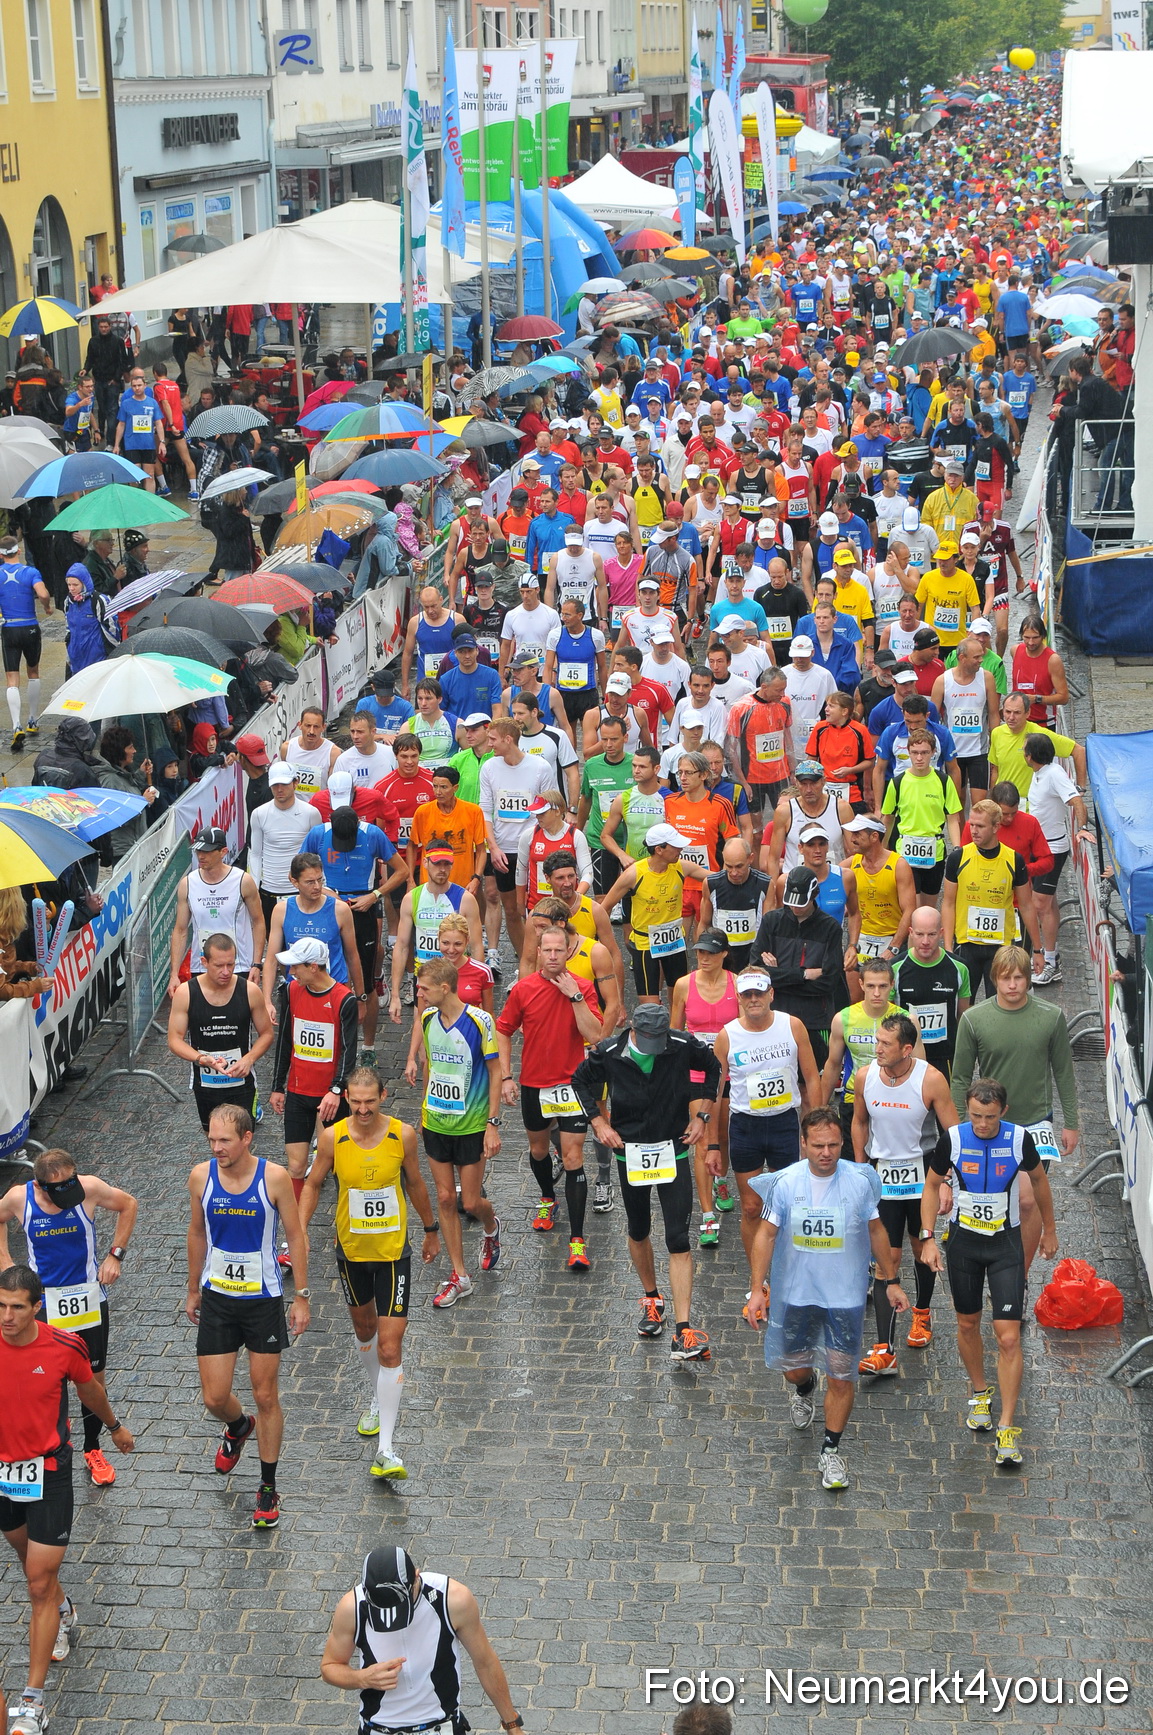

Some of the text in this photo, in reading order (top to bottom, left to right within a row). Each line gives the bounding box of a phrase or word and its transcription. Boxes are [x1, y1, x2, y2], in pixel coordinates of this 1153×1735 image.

[279, 35, 314, 66] R.
[169, 113, 240, 148] BRILLEN WEBER
[746, 498, 754, 506] 15
[790, 502, 808, 512] 2033
[937, 613, 958, 623] 2226
[771, 622, 787, 633] 112
[567, 670, 579, 680] 45
[790, 694, 817, 702] Xplus1
[954, 714, 980, 726] 2049
[762, 741, 780, 752] 202
[499, 798, 528, 810] 3419
[630, 806, 663, 815] BOCK
[675, 823, 705, 831] SportScheck
[904, 844, 933, 857] 3064
[725, 919, 750, 933] 818
[975, 916, 998, 931] 188
[293, 926, 327, 934] ELOTEC
[653, 927, 680, 945] 2002
[866, 942, 879, 956] 71
[45, 953, 53, 965] TUI
[300, 1030, 325, 1048] 605
[300, 1047, 322, 1057] Andreas
[750, 1042, 790, 1055] HÖRGERÄTE
[431, 1052, 465, 1064] BOCK
[751, 1048, 791, 1063] MECKLER
[430, 1080, 460, 1101] 2000
[757, 1078, 785, 1098] 323
[551, 1087, 569, 1103] 16
[434, 1101, 454, 1110] Michael
[550, 1104, 575, 1113] Christian
[767, 1099, 779, 1107] Udo
[641, 1153, 660, 1169] 57
[643, 1171, 661, 1179] Frank
[882, 1167, 919, 1184] 2021
[887, 1187, 916, 1195] Wolfgang
[364, 1201, 386, 1217] 69
[973, 1205, 993, 1220] 36
[361, 1219, 388, 1228] Thomas
[802, 1219, 834, 1237] 645
[35, 1225, 77, 1238] LAC QUELLE
[804, 1239, 831, 1247] Richard
[225, 1263, 246, 1281] 44
[396, 1275, 406, 1305] SKINS
[58, 1295, 89, 1317] 681
